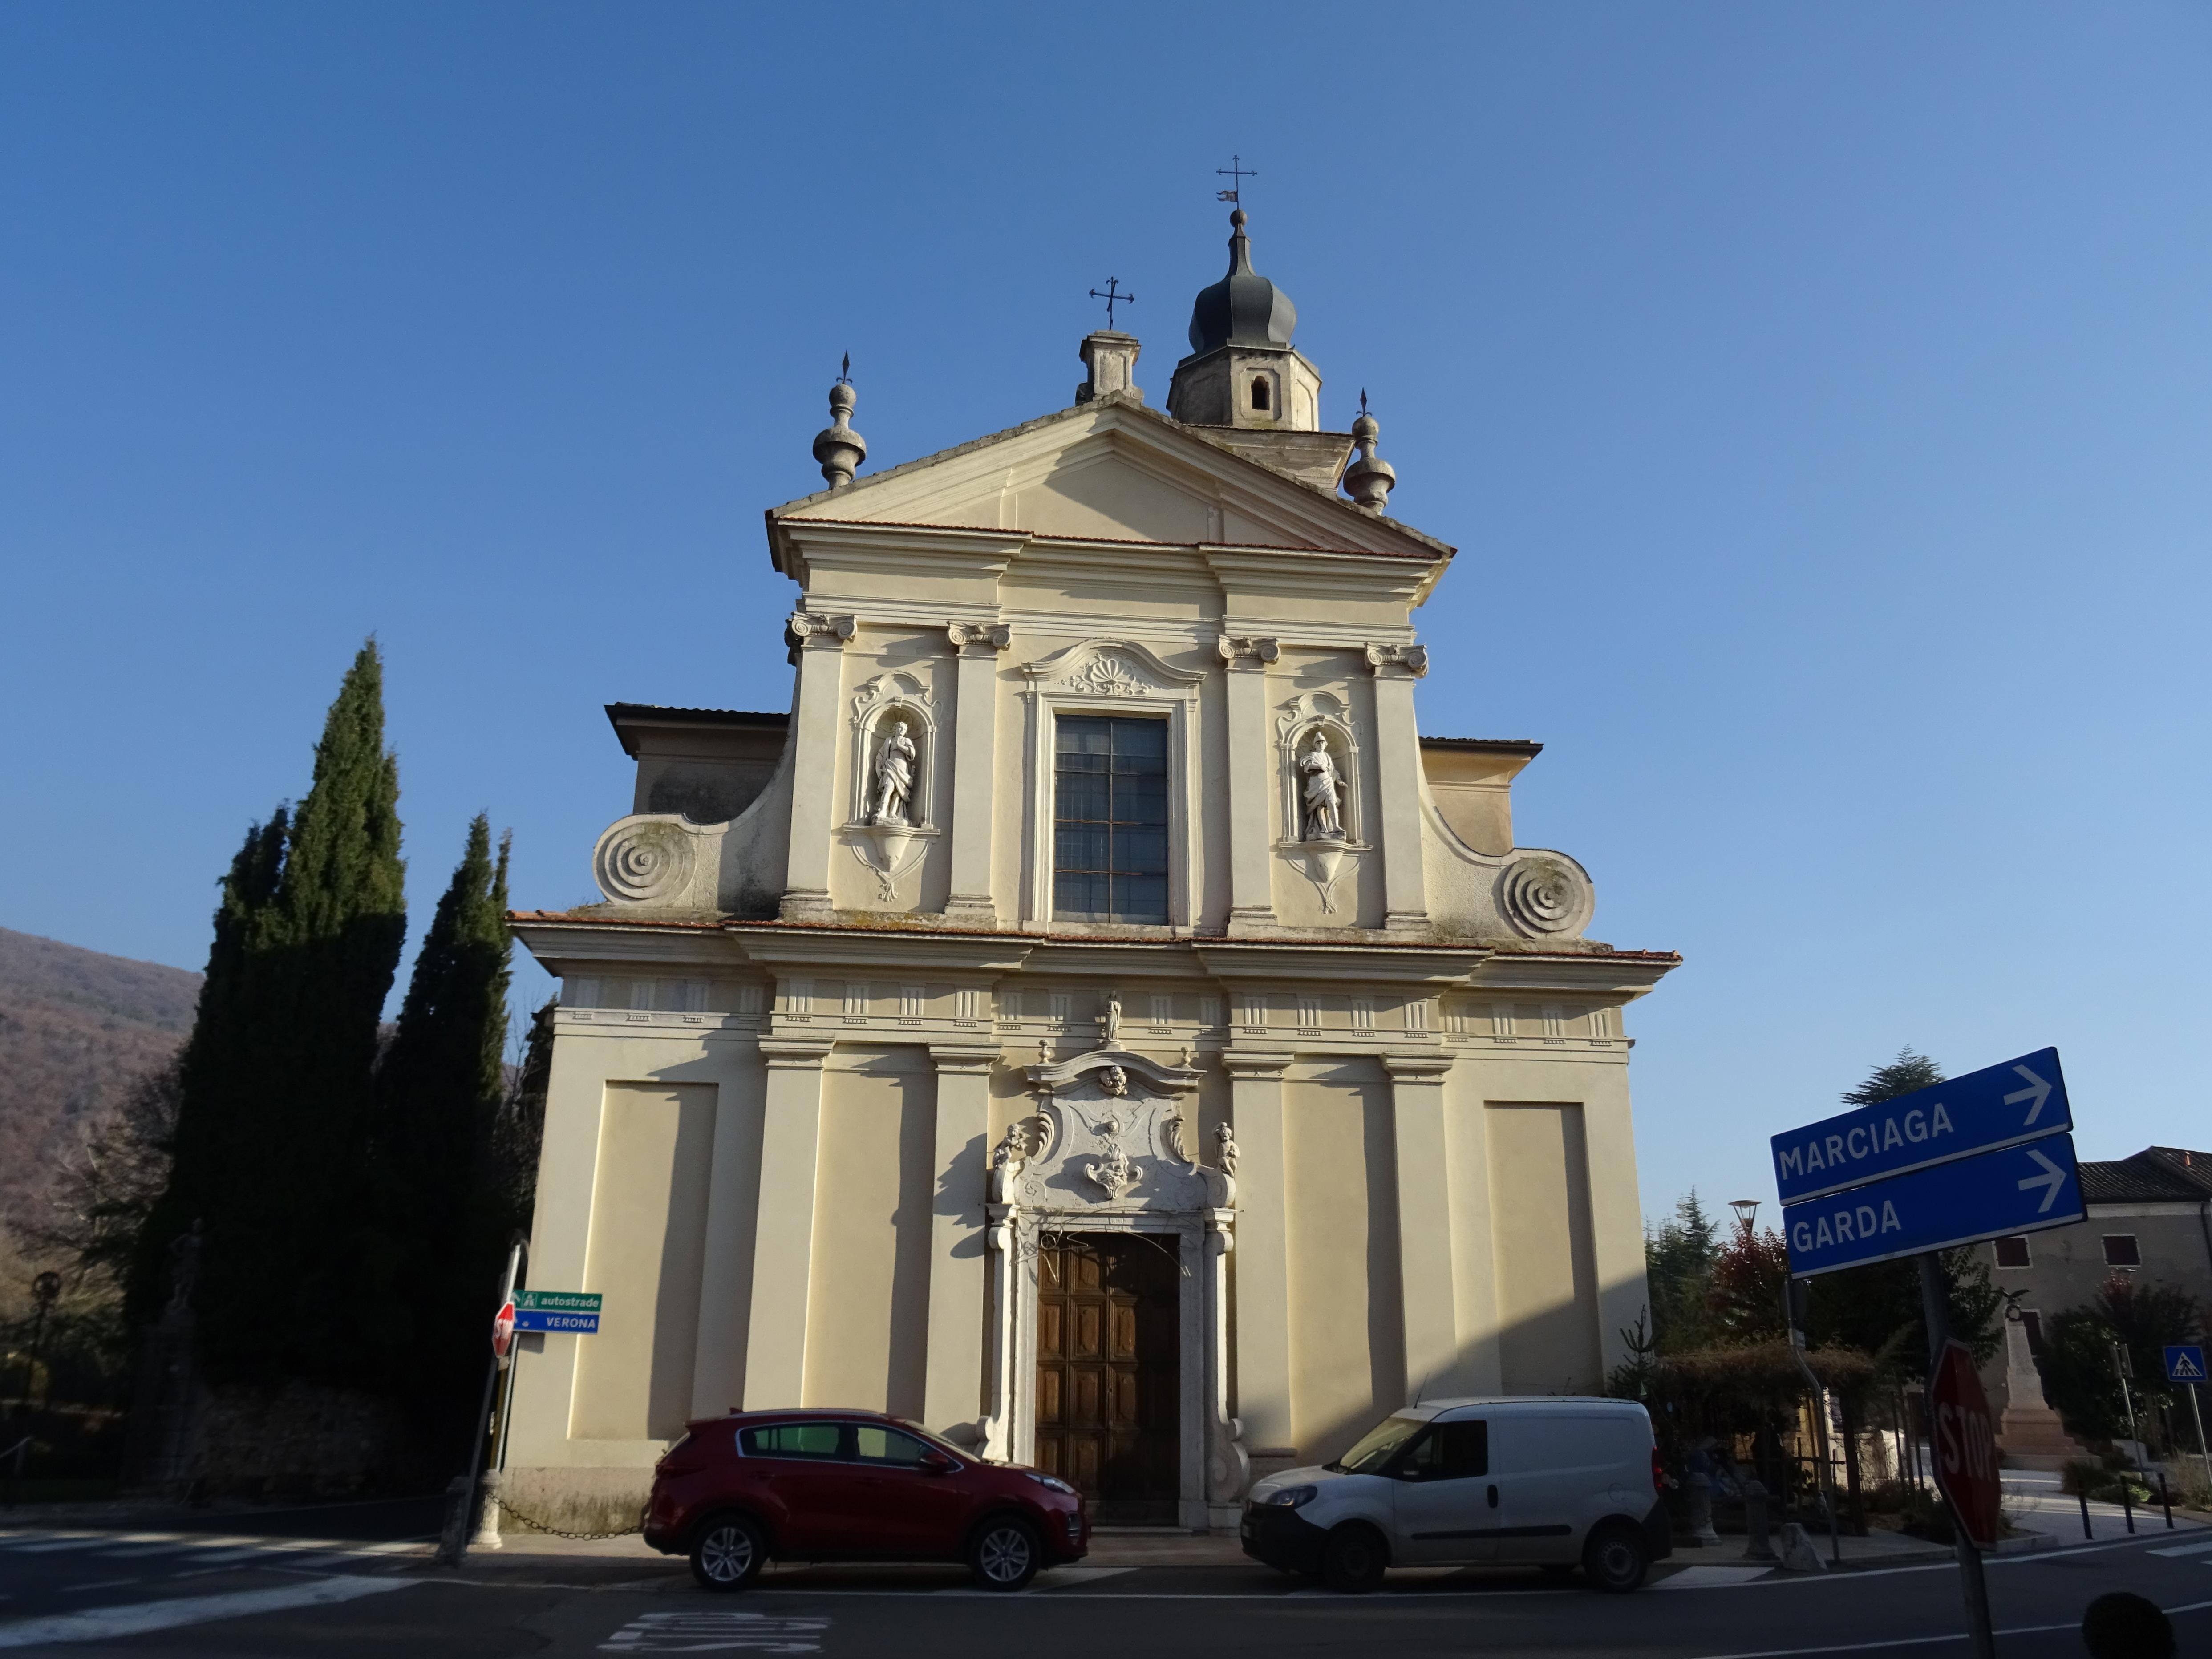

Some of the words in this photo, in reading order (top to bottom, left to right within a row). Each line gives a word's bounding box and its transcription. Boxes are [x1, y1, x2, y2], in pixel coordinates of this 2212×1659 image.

[1779, 1102, 1954, 1181] MARCIAGA
[1792, 1200, 1901, 1252] GARDA
[541, 1296, 599, 1307] autostrade
[546, 1317, 596, 1328] VERONA
[1938, 1401, 1993, 1482] STOP
